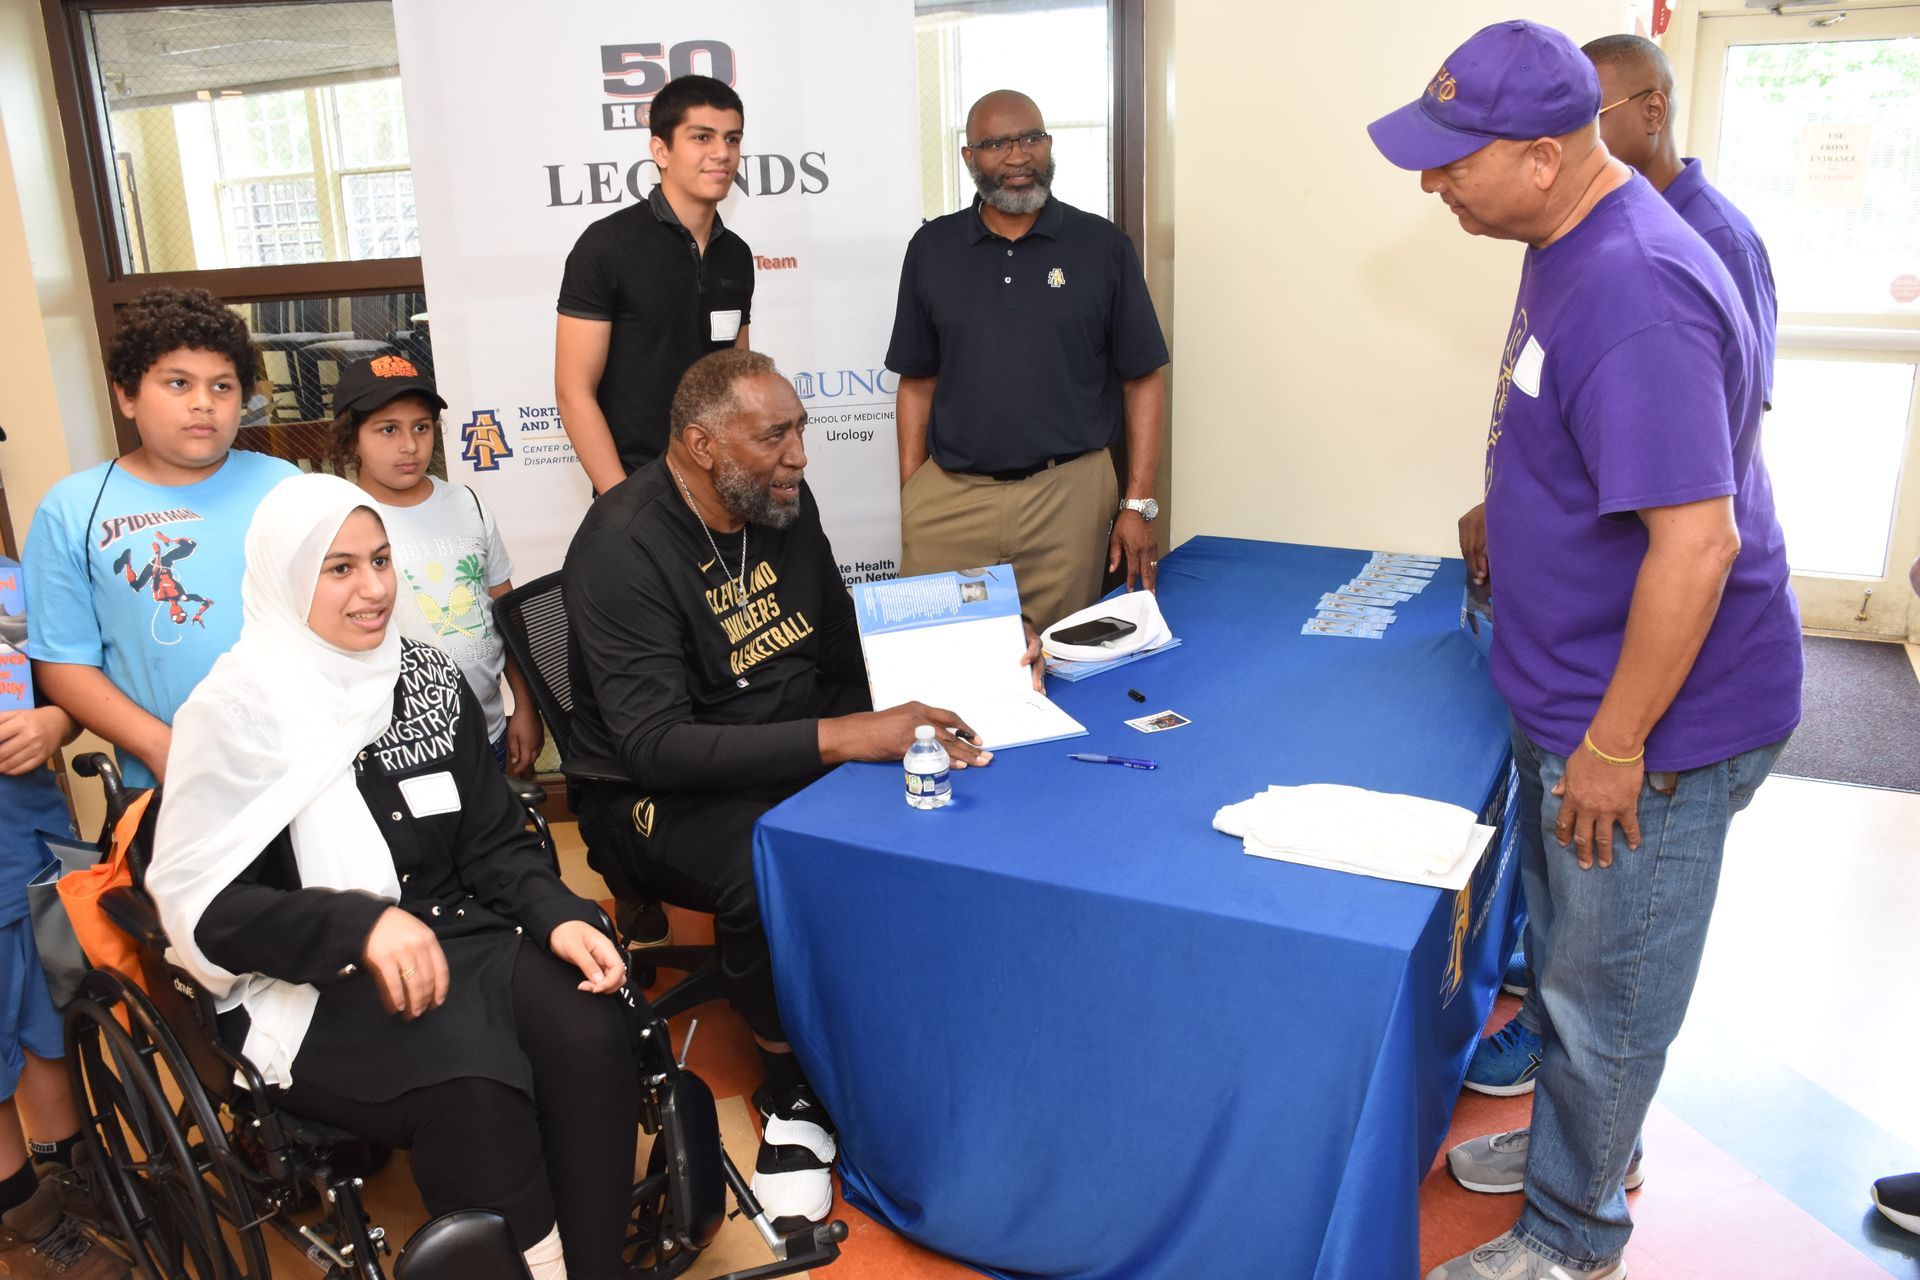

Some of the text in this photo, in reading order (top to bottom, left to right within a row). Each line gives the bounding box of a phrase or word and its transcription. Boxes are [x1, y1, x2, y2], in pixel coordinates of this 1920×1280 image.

[600, 39, 737, 98] 50
[1820, 143, 1850, 151] FRONT
[1809, 155, 1857, 163] ENTRANCE
[543, 151, 830, 207] LEGNDS
[754, 254, 798, 271] Team
[816, 368, 898, 398] UNC
[806, 411, 895, 425] CHOOL OF MEDICINE
[826, 429, 875, 442] Urology
[562, 444, 574, 452] O
[855, 559, 895, 573] Health
[843, 575, 862, 585] ion
[730, 611, 814, 676] BASKETBALL
